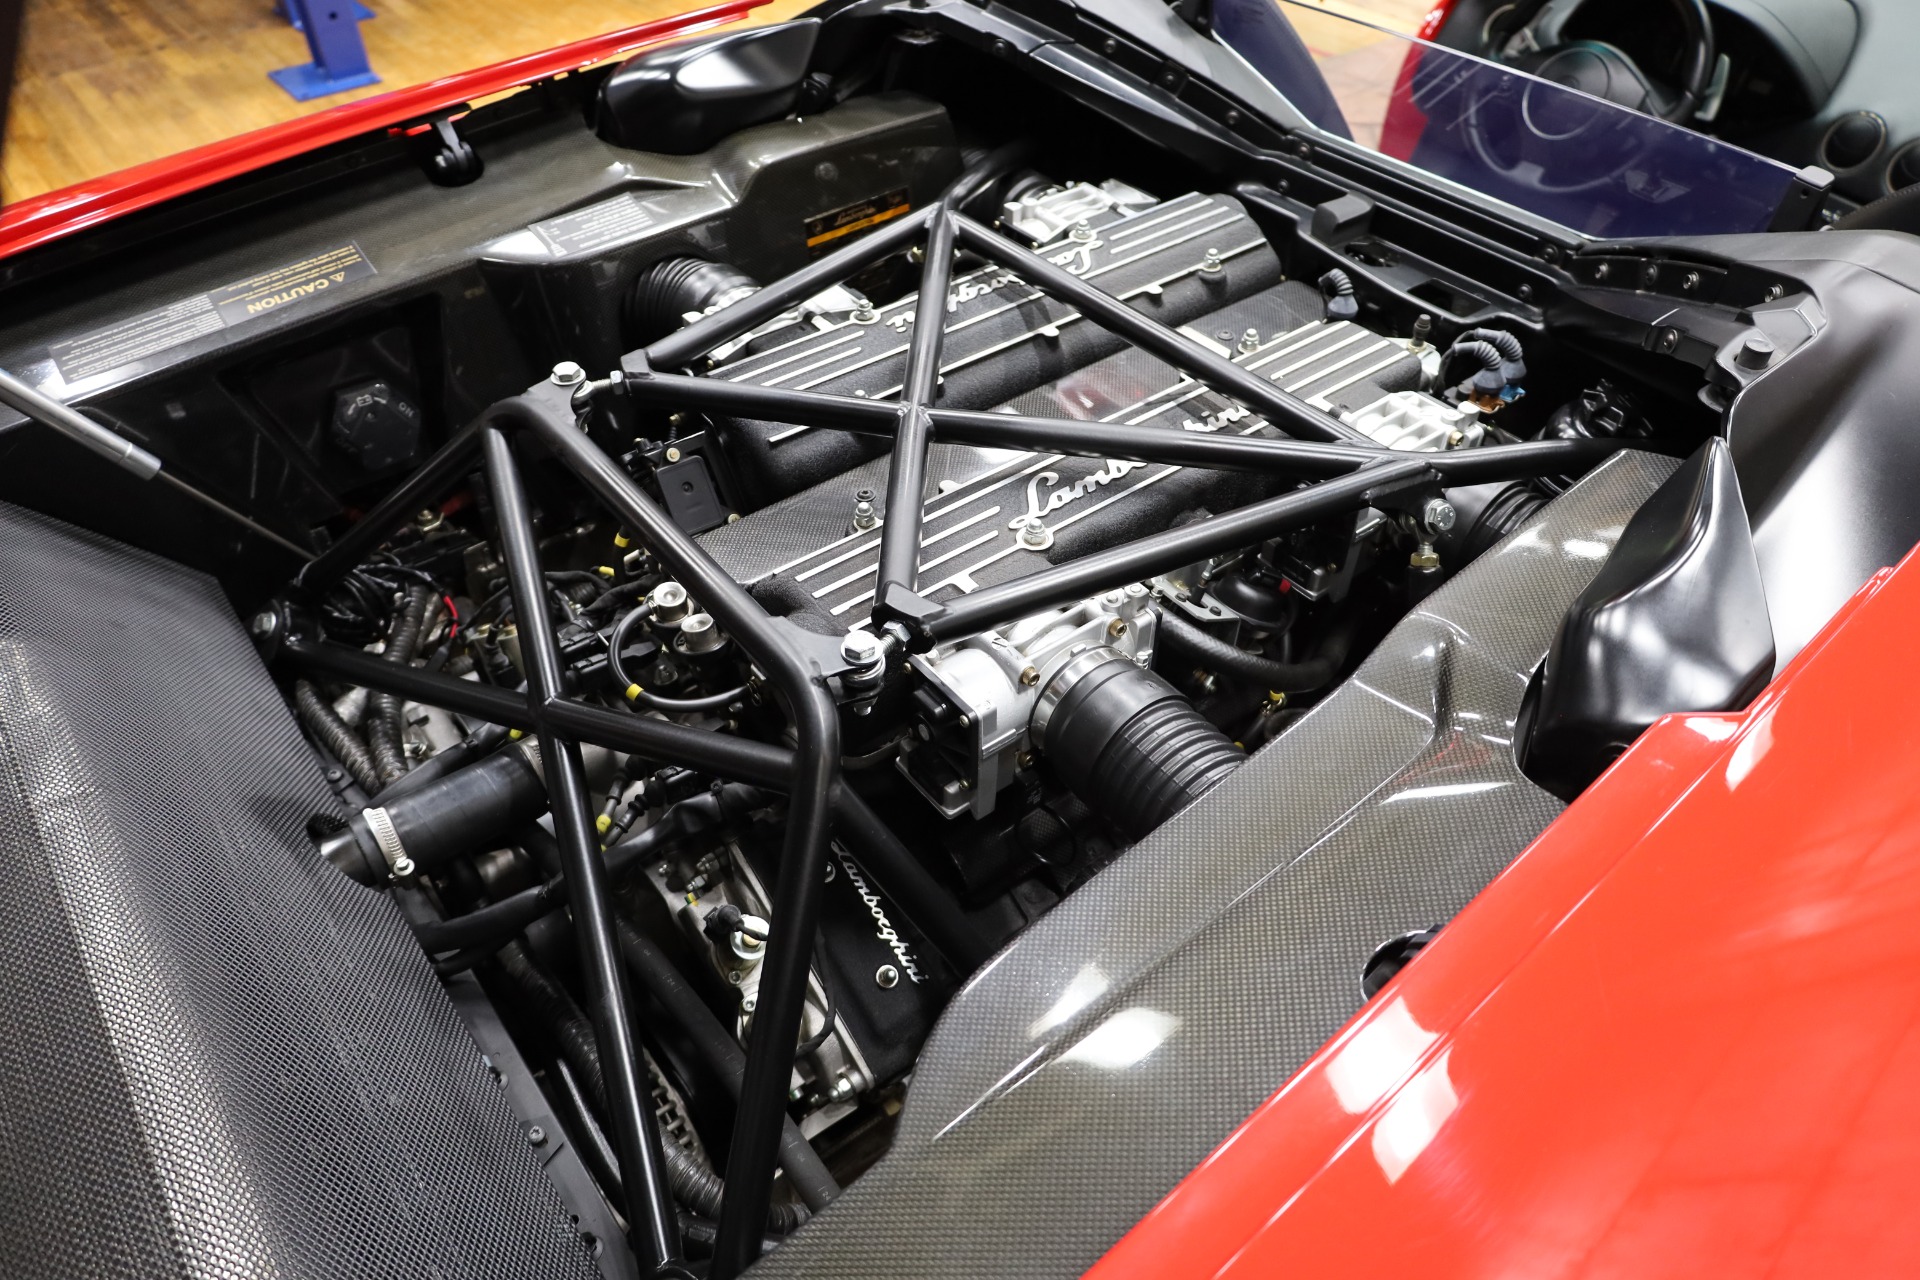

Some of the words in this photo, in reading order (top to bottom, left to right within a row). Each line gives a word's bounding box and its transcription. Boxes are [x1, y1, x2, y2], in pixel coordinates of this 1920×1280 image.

[246, 278, 330, 314] CAUTION
[398, 402, 415, 418] ON
[831, 841, 930, 984] Lamborghini
